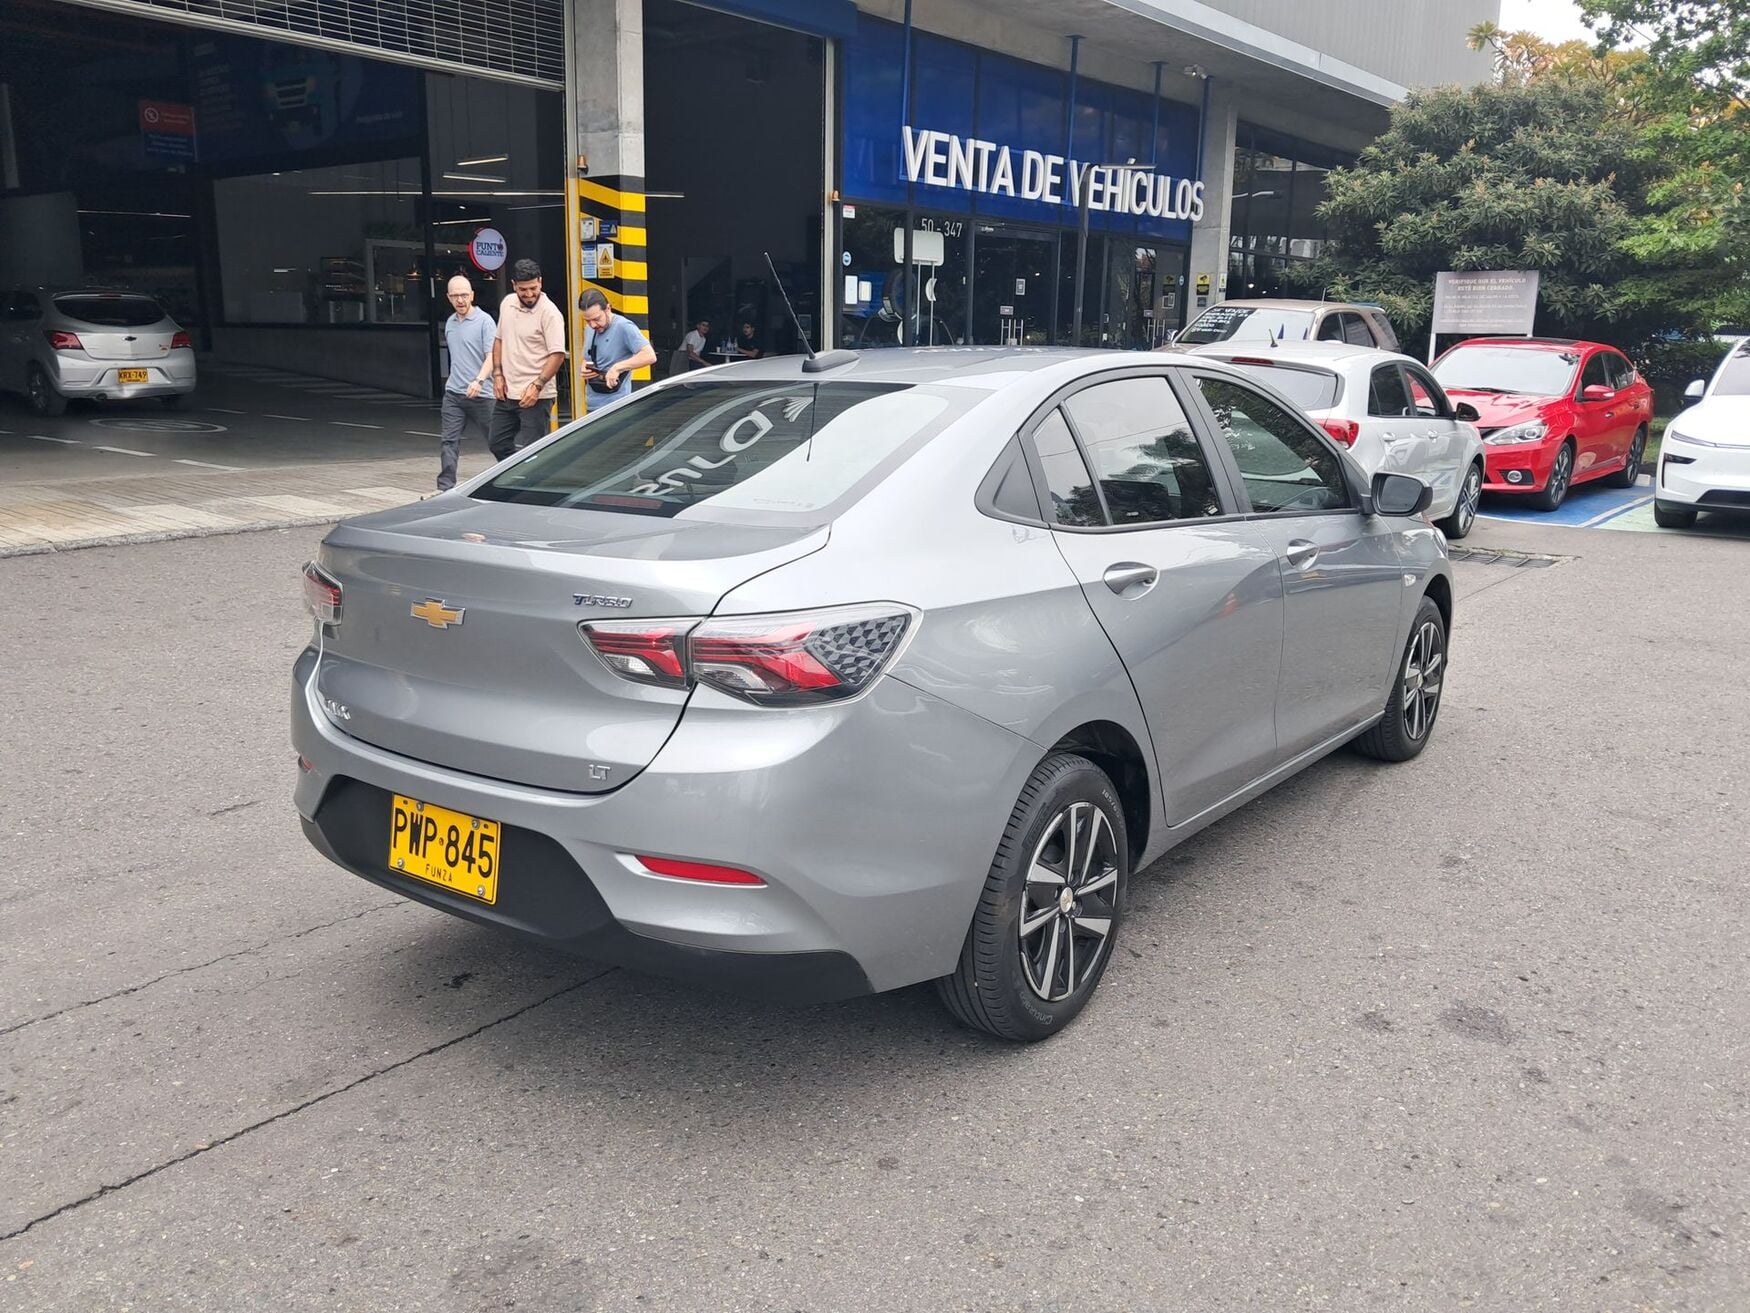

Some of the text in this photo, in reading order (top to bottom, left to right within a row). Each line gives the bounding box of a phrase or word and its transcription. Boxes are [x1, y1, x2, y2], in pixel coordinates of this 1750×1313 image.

[902, 125, 1205, 222] VENTA DE VEHÍCULOS
[944, 221, 963, 238] 347
[573, 593, 633, 609] TURBO
[589, 764, 611, 780] LT
[425, 863, 454, 883] FUNZA
